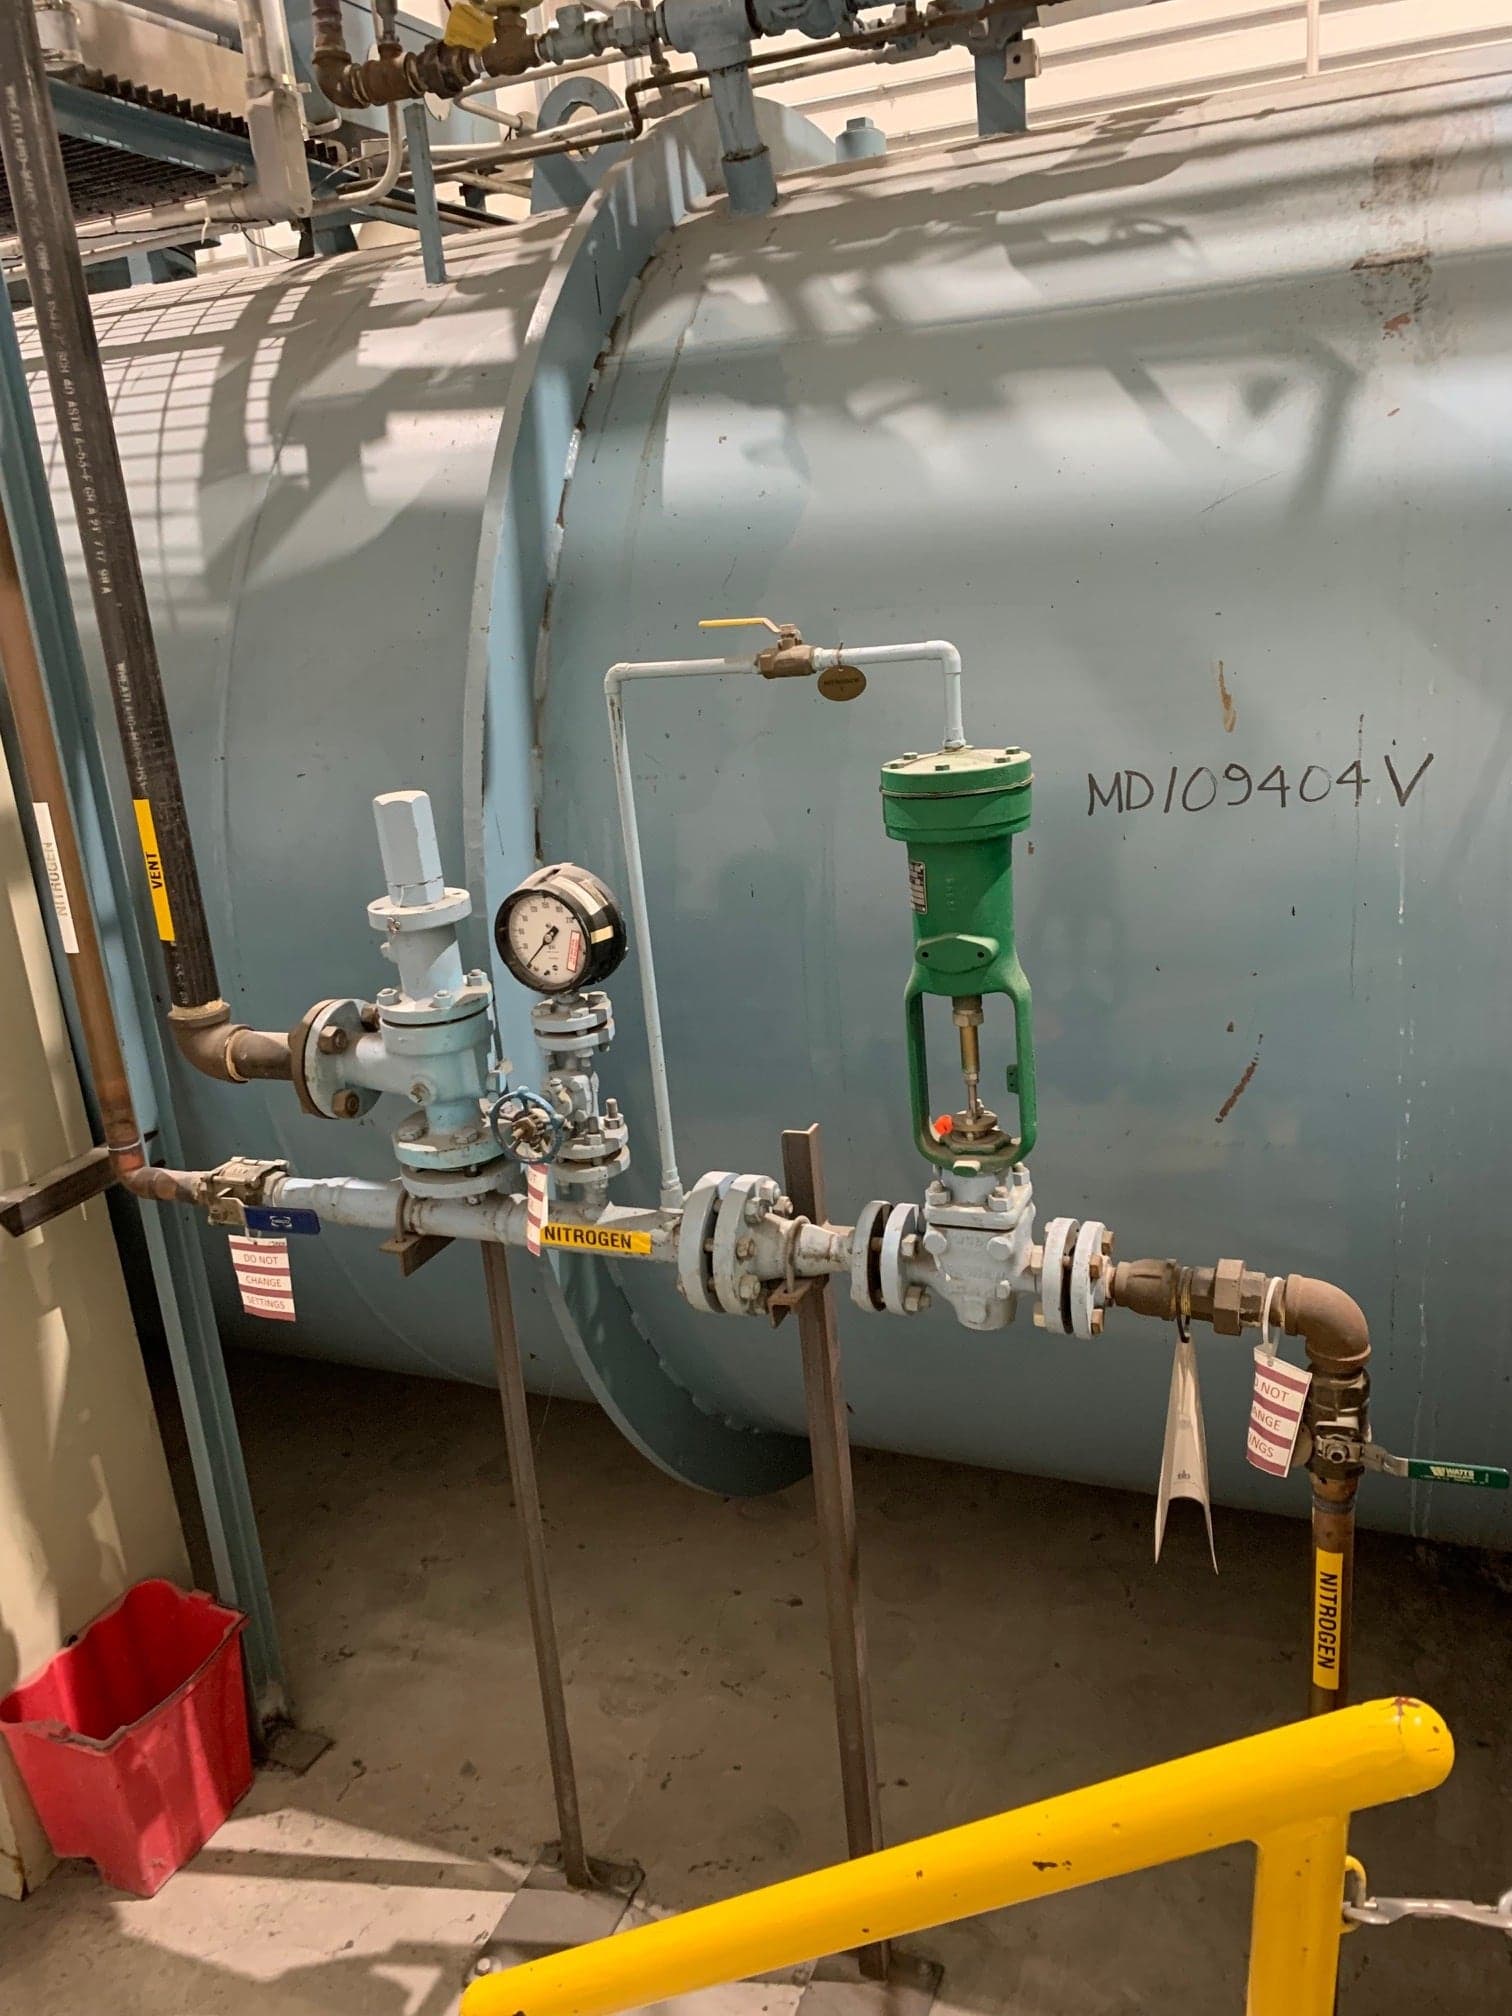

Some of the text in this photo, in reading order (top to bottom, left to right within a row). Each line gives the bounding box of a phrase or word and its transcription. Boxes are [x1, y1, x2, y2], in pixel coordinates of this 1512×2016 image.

[67, 400, 82, 432] ASTM
[144, 852, 163, 890] VENT
[544, 1226, 632, 1249] NITROGEN
[243, 1254, 279, 1265] DO NOT
[245, 1275, 282, 1288] CHANGE
[247, 1297, 286, 1310] SETTINGS
[1261, 1382, 1290, 1402] NOT
[1445, 1467, 1474, 1479] WATTS
[1317, 1571, 1338, 1669] NITROGEN
